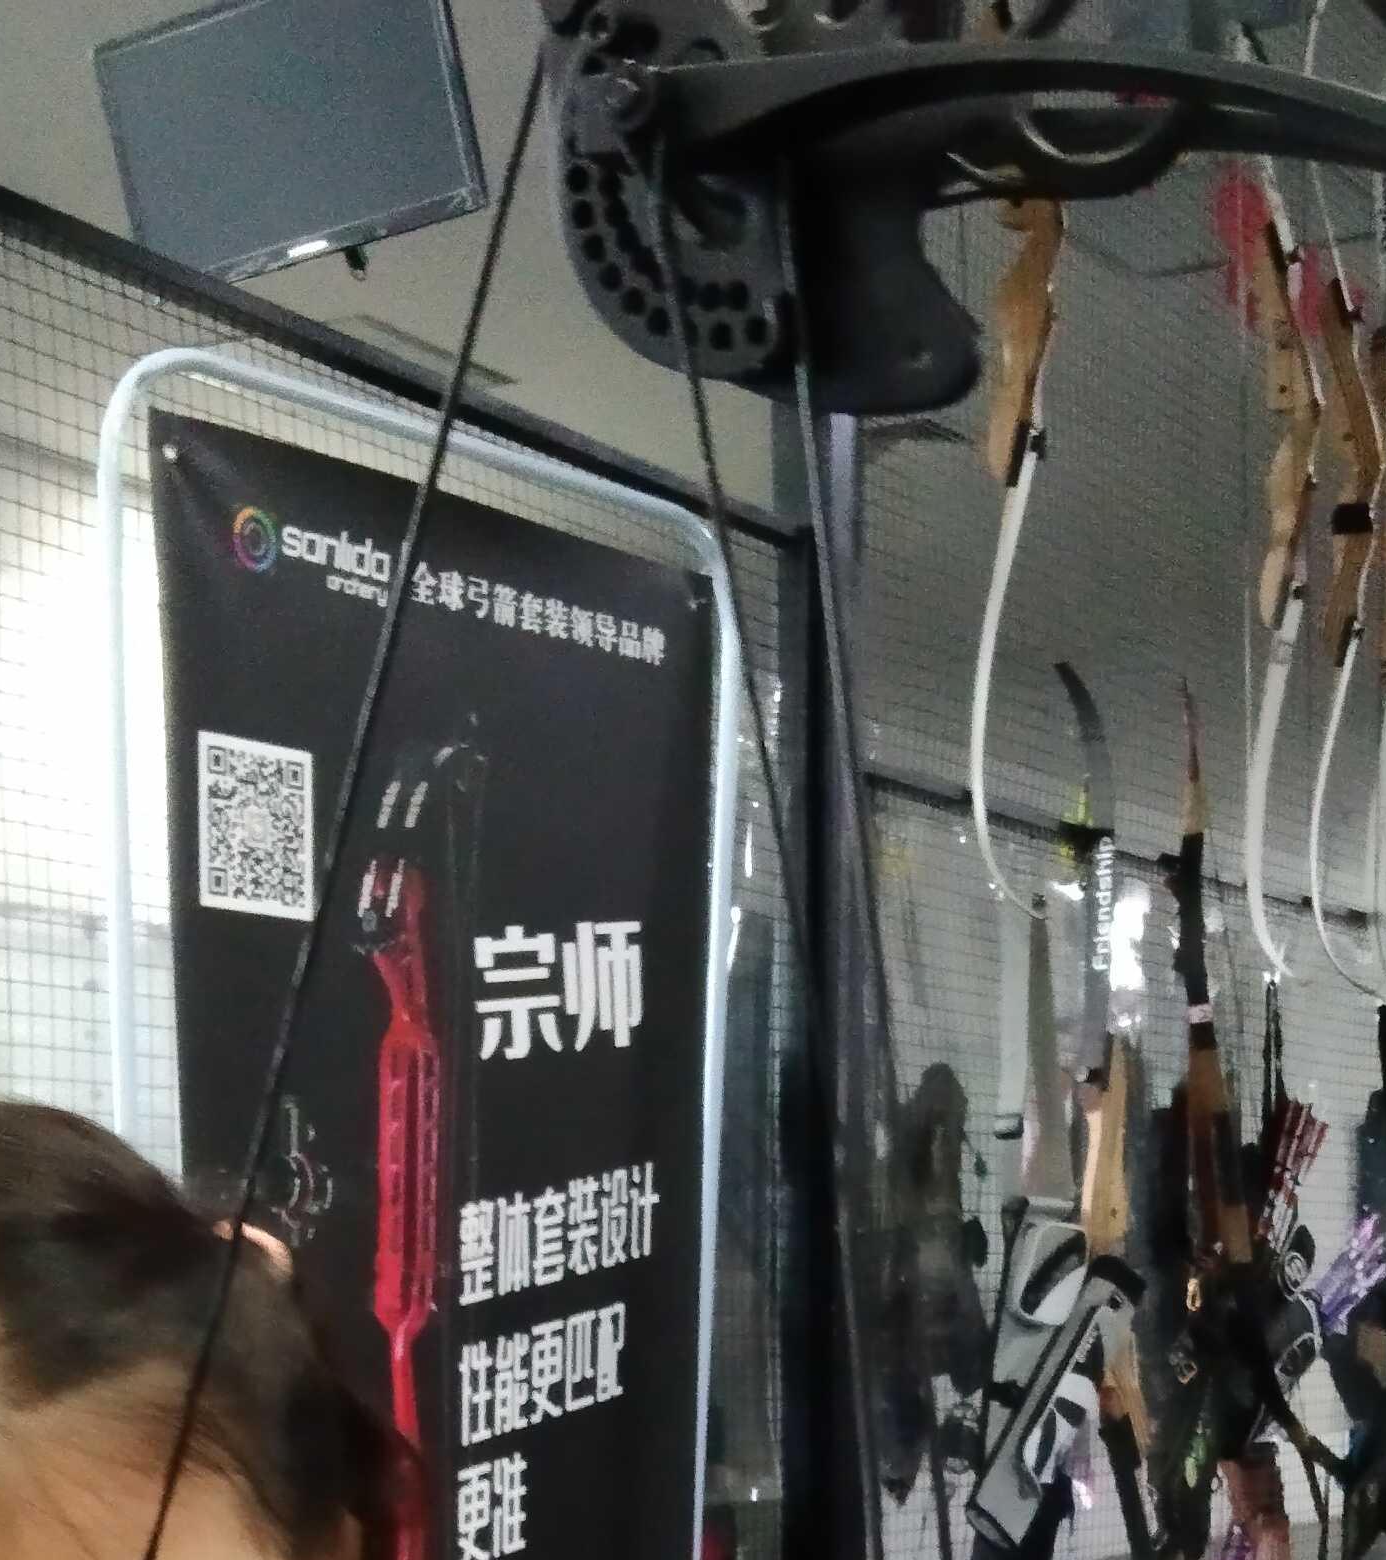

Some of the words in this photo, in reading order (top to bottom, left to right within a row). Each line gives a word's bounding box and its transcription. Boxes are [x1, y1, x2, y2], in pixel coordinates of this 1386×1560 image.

[281, 524, 391, 584] sanlida
[411, 562, 667, 667] 全球弓箭套装领导品牌
[474, 921, 644, 1061] 宗师
[459, 1161, 660, 1306] 整体套装设计
[458, 1302, 627, 1447] 性能更匹配
